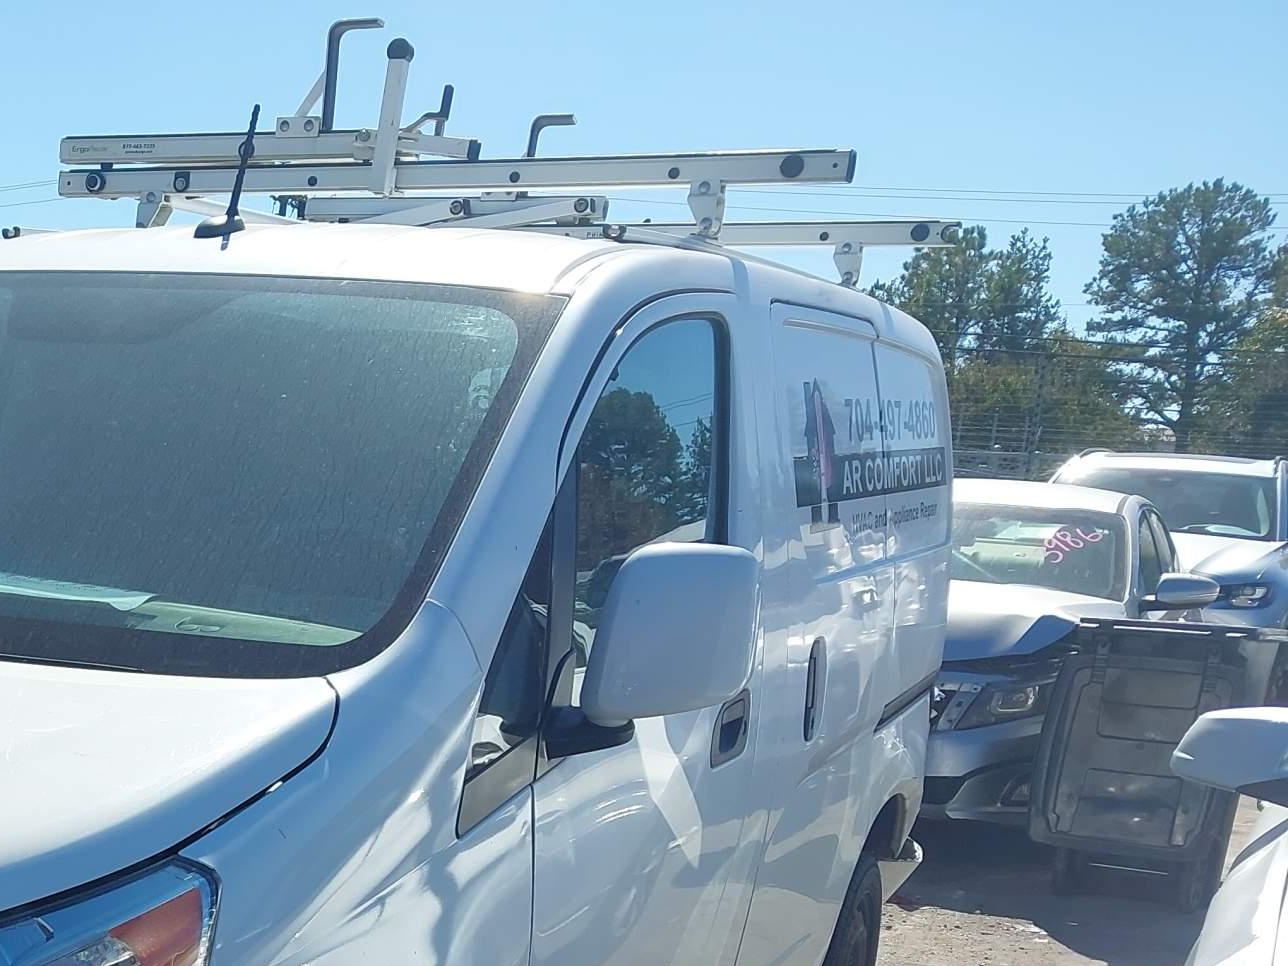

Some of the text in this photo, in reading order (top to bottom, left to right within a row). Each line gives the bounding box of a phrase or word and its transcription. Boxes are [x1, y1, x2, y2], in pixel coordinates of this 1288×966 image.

[844, 398, 936, 441] 704-497-4860
[843, 454, 942, 494] AR COMFORT LLC
[852, 511, 872, 533] HVAC
[874, 508, 887, 529] and
